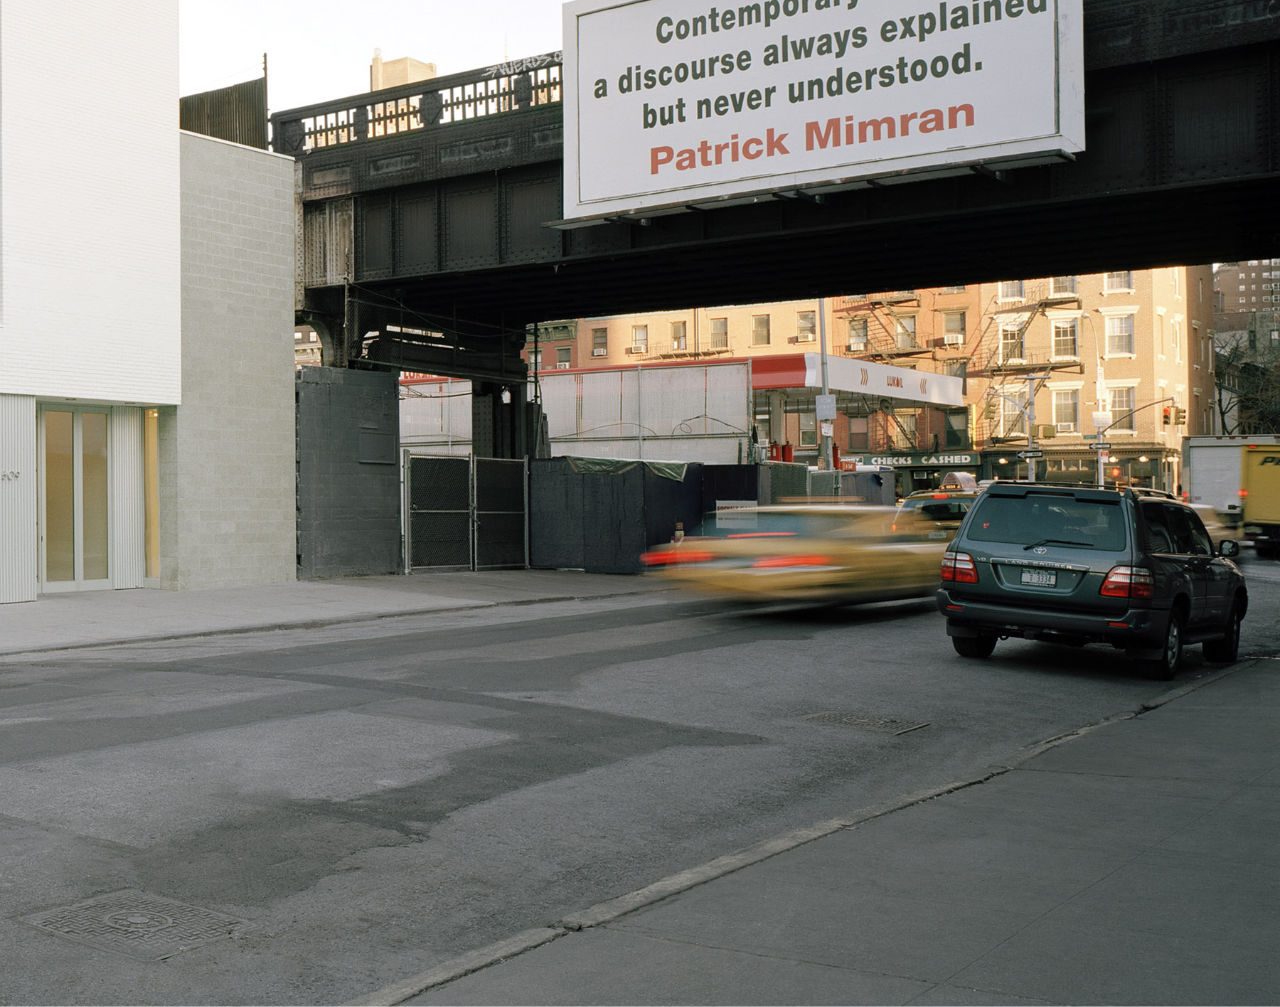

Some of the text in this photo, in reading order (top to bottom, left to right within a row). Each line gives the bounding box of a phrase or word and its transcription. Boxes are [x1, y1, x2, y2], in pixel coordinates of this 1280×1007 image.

[594, 78, 608, 99] a
[618, 50, 752, 94] discourse
[763, 26, 868, 67] always
[643, 42, 983, 129] but never understood.
[650, 103, 975, 176] Patrick Mimran
[871, 456, 912, 465] CHECKS
[921, 455, 971, 464] CASHED
